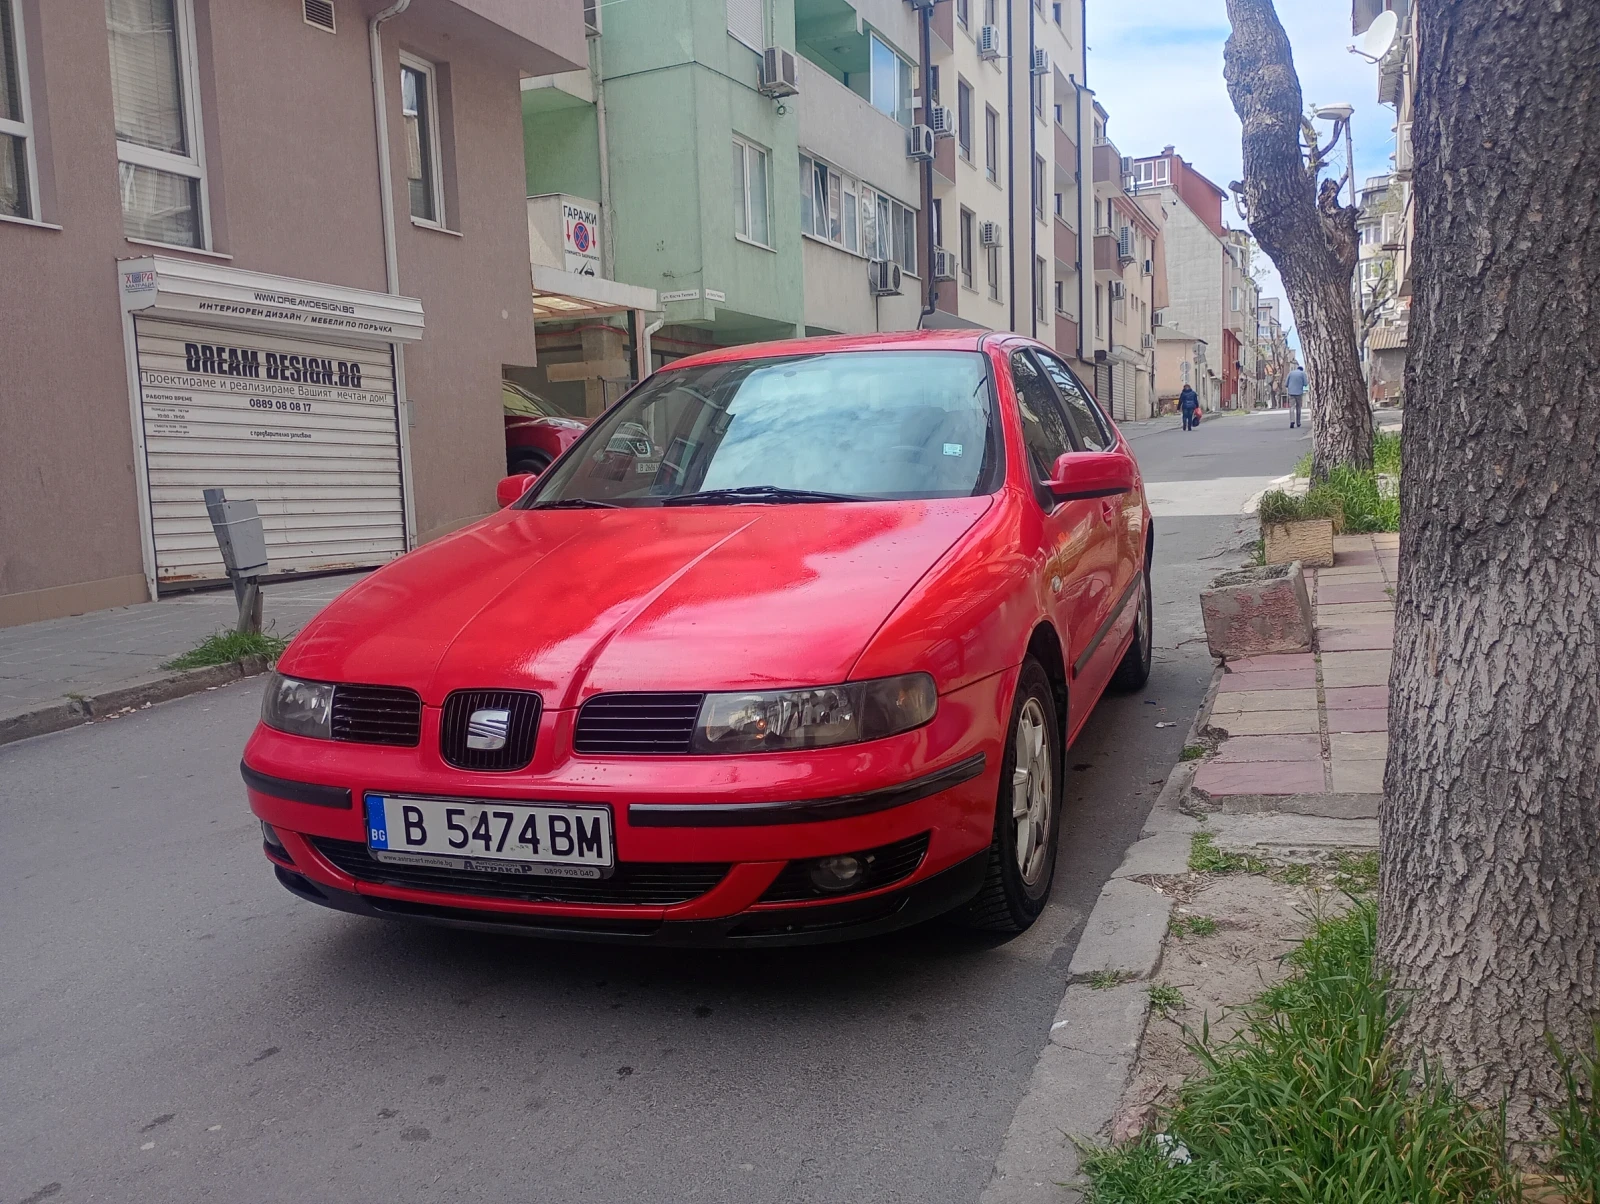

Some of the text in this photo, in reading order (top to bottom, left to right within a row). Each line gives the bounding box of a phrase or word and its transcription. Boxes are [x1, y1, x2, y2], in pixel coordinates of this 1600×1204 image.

[563, 205, 597, 226] ГАРАЖИ
[254, 292, 355, 314] WWW.DREAMDESIGN.BG
[199, 302, 263, 316] ИНТЕРИОРЕН
[264, 310, 302, 322] ДИЗАЙН
[310, 316, 344, 327] МЕБЕЛИ
[344, 321, 357, 329] ПО
[357, 322, 393, 334] ПОРЪЧКА
[185, 343, 361, 388] DREAM DESIGN.BG
[141, 371, 216, 386] Проектираме
[220, 381, 227, 390] и
[229, 381, 295, 395] реализираме
[298, 385, 332, 398] Вашият
[337, 390, 367, 402] мечтан
[145, 393, 174, 401] РАБОТНО
[249, 398, 312, 412] 0889 08 08 17
[371, 828, 386, 842] BG
[402, 805, 428, 846] B
